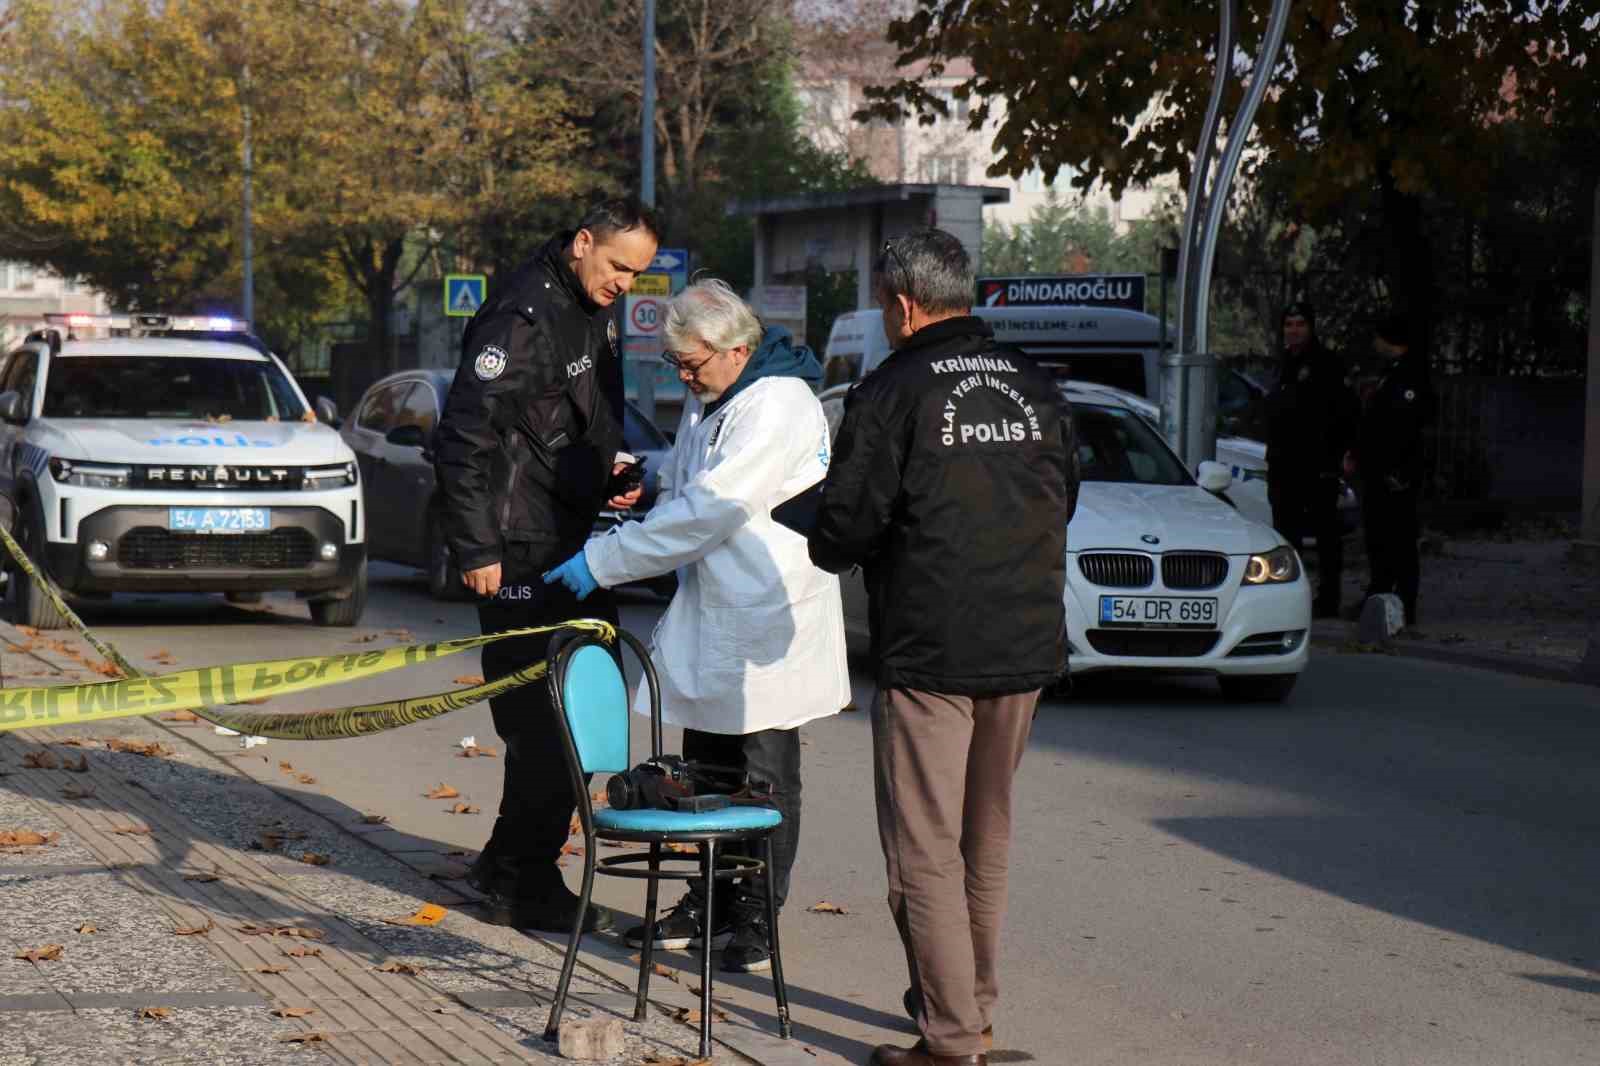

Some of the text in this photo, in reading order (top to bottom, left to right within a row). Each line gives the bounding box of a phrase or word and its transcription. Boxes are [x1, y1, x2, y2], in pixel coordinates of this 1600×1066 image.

[1008, 278, 1131, 301] DİNDAROĞLU
[638, 307, 656, 323] 30
[930, 355, 1018, 374] KRİMİNAL
[941, 373, 1042, 446] OLAY YERİ İNCELEME
[960, 419, 1026, 443] POLİS
[148, 466, 288, 481] RENAULT
[175, 511, 195, 528] 54
[202, 512, 215, 528] A
[498, 585, 532, 600] OLİS
[1113, 599, 1213, 620] 54 DR 699
